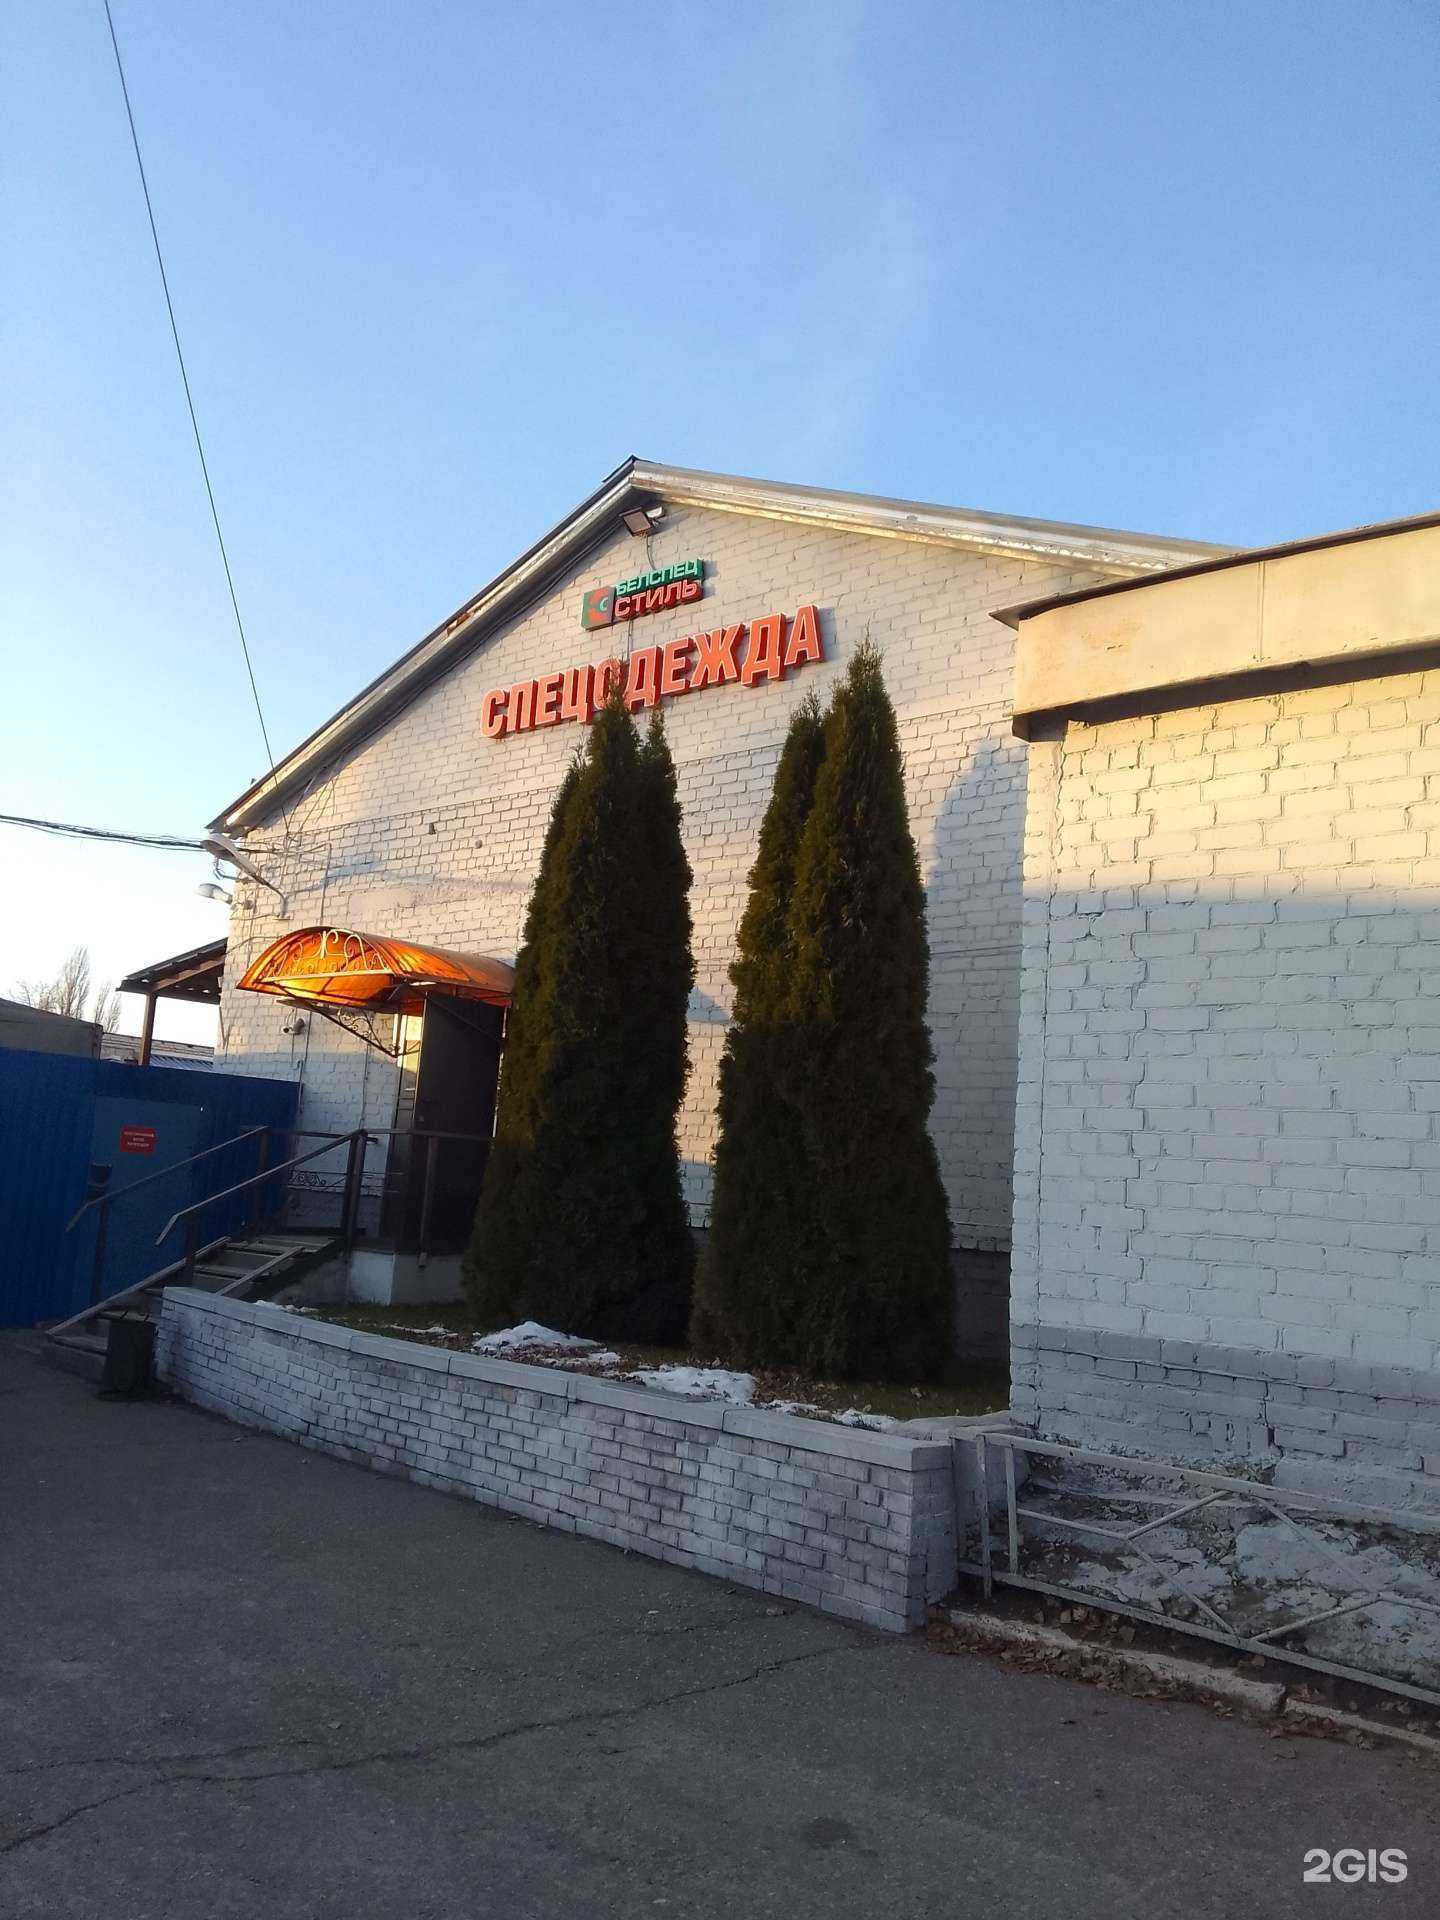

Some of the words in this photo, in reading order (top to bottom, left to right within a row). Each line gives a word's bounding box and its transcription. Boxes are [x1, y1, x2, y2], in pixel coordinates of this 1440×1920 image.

[616, 559, 700, 595] БЕЛСПЕЦ
[614, 579, 699, 618] СТИЛЬ
[480, 604, 823, 738] СПЕЦОДЕЖДА
